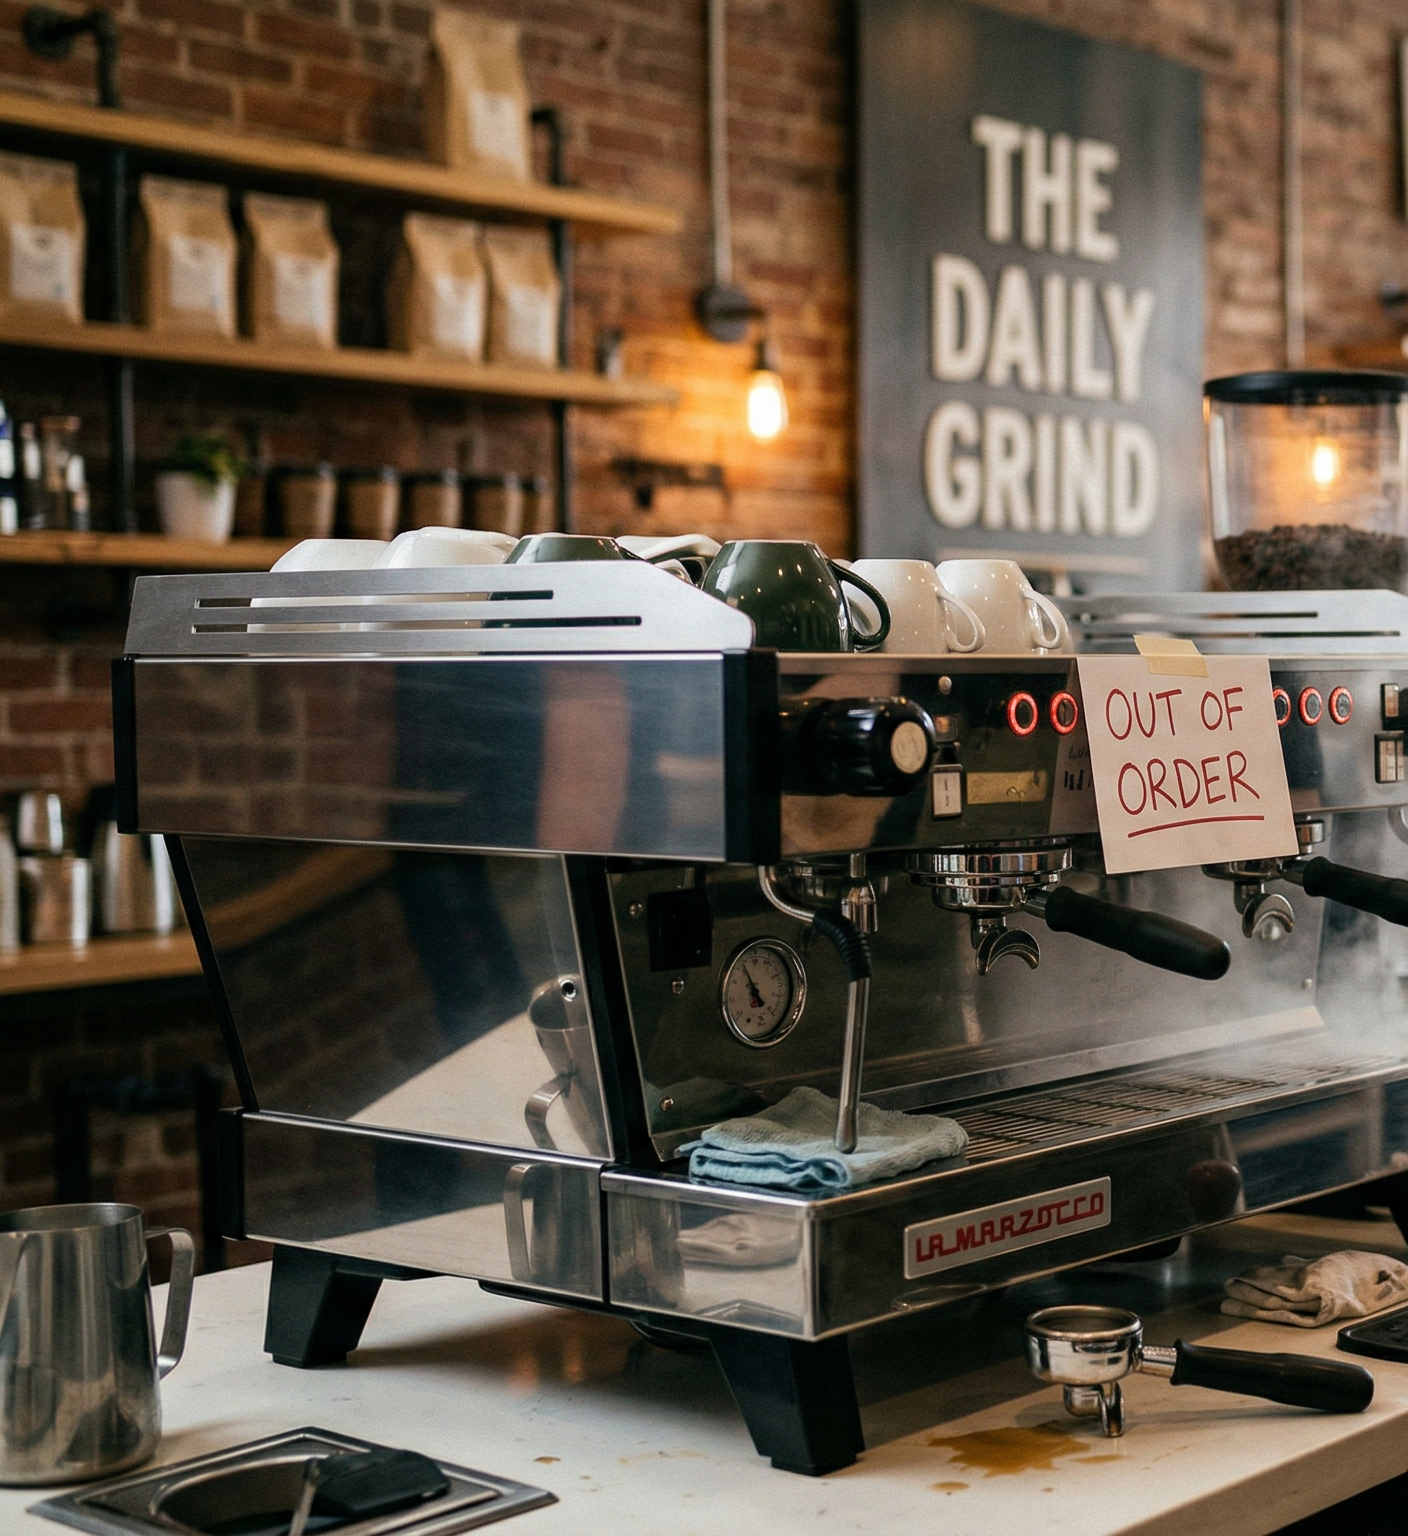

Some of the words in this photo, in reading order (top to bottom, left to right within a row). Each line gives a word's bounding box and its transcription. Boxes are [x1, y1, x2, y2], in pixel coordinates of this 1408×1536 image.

[972, 115, 1119, 262] THE
[931, 252, 1155, 401] DAILY
[925, 401, 1162, 538] GRIND
[1105, 687, 1182, 740] OUT
[1200, 686, 1243, 731] OF
[1117, 750, 1261, 815] ORDER
